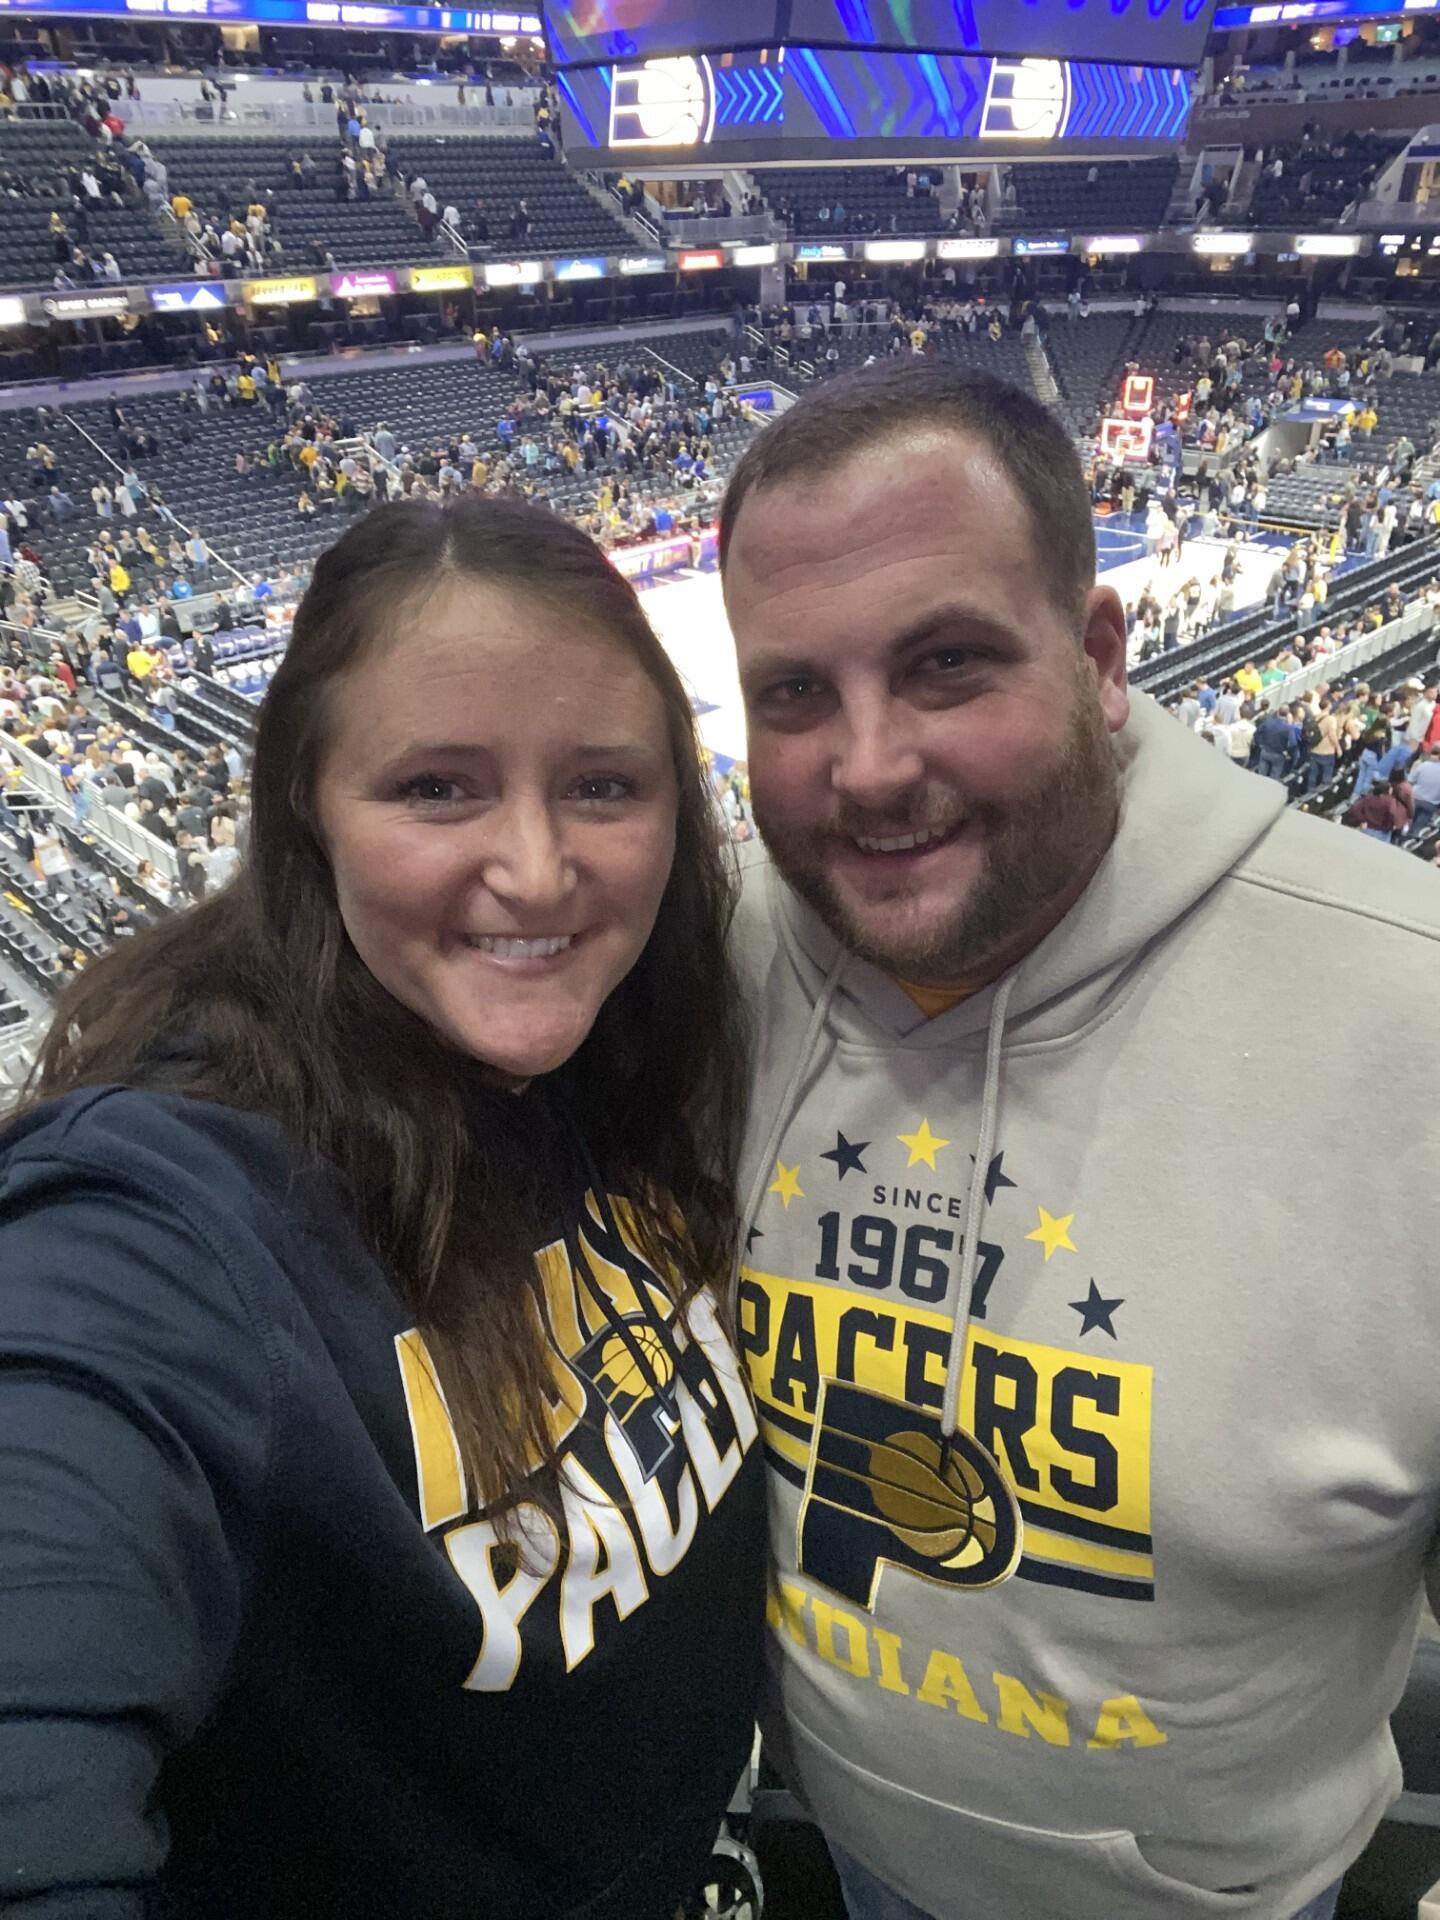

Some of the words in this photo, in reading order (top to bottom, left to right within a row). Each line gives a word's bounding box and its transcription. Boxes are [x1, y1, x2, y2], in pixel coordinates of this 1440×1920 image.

[873, 1184, 962, 1219] SINCE
[815, 1211, 1005, 1320] 1967
[766, 1582, 1168, 1750] NDIANA
